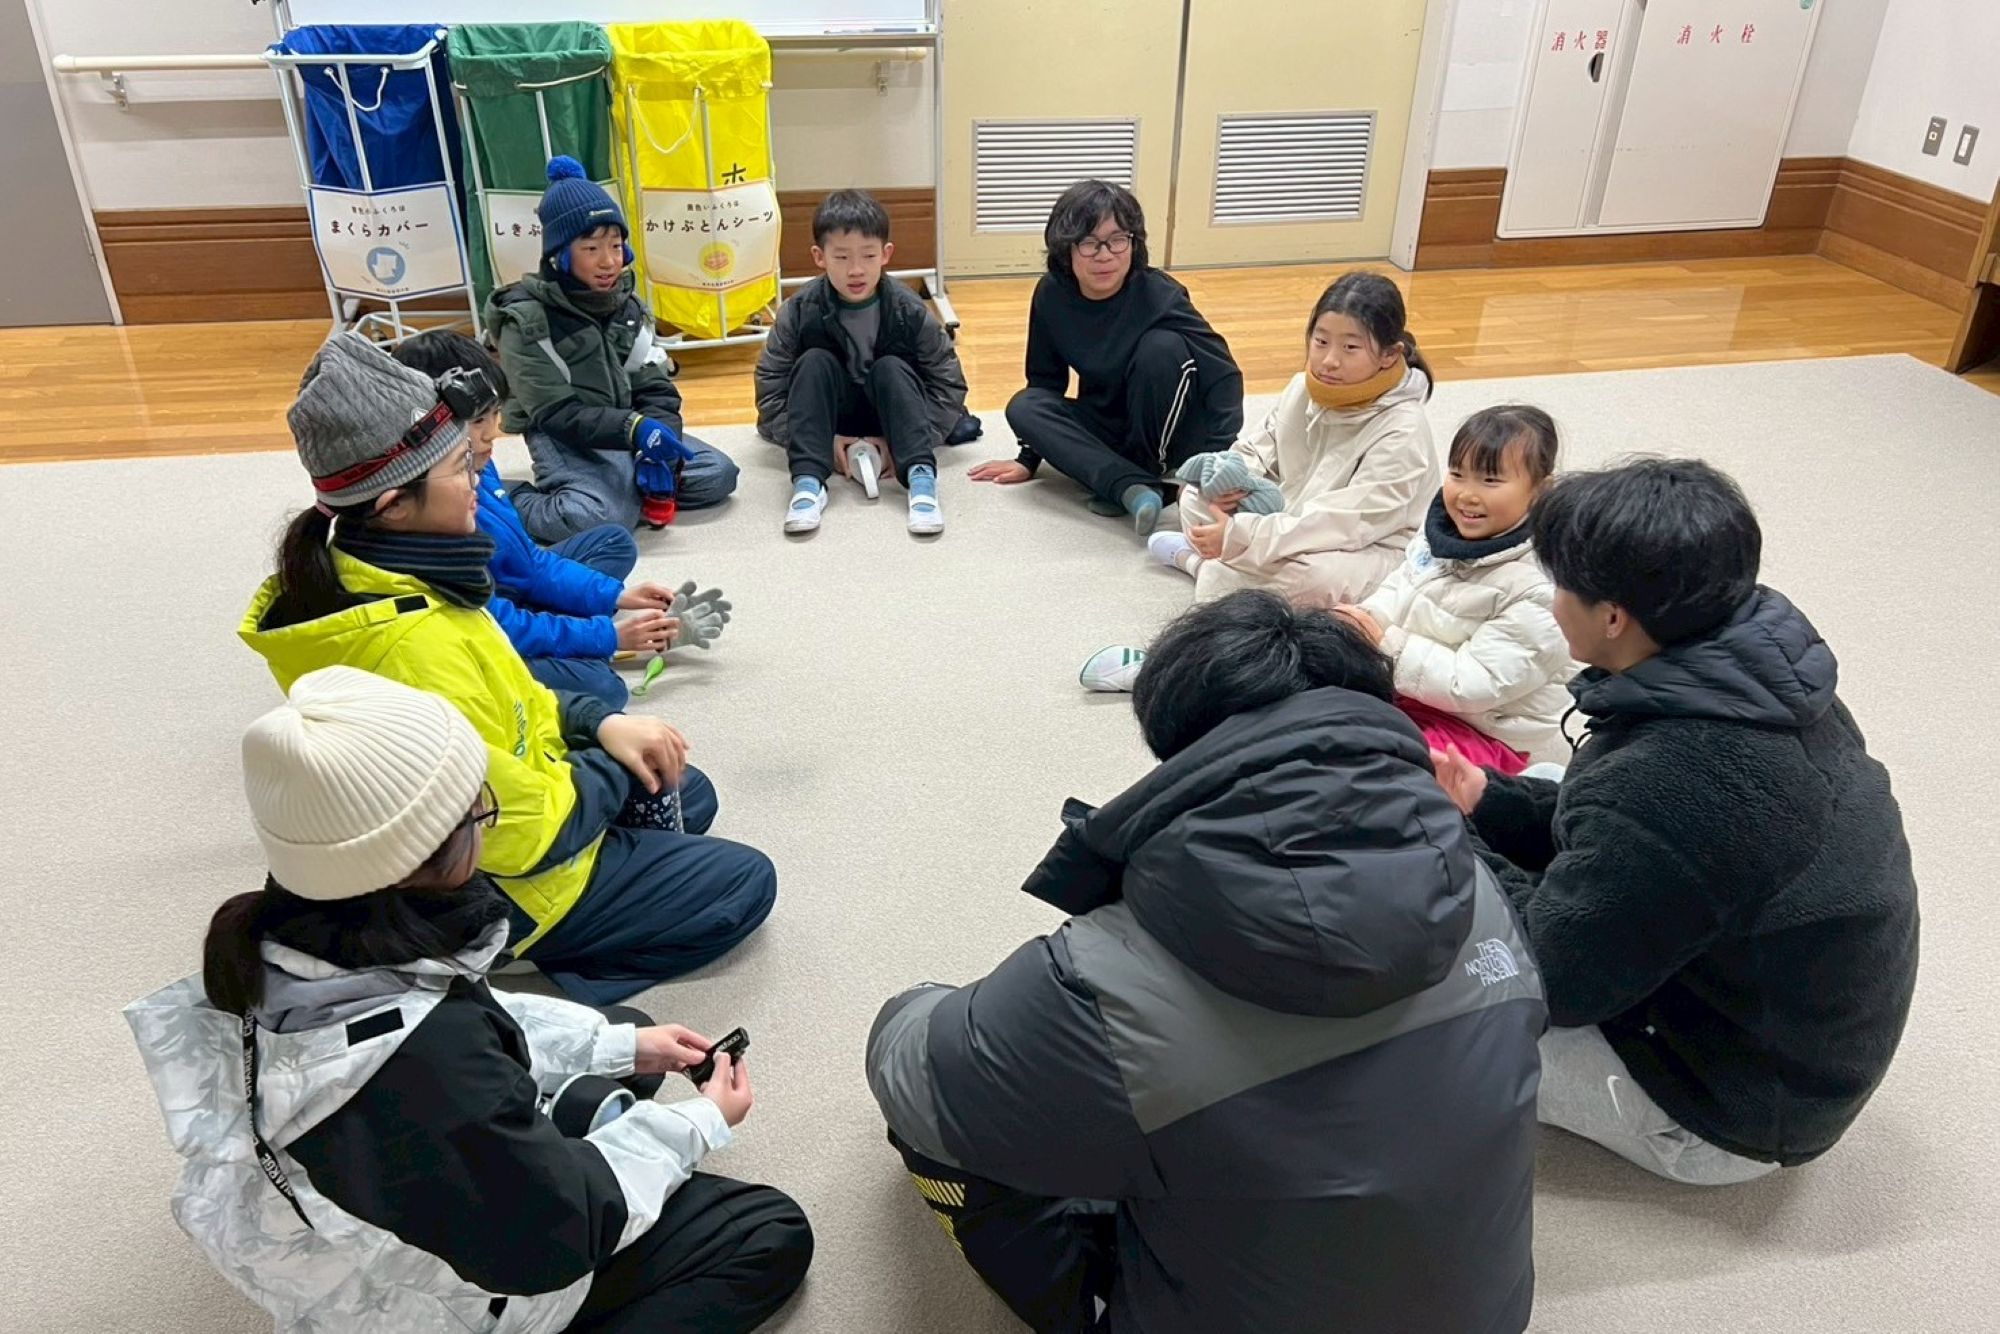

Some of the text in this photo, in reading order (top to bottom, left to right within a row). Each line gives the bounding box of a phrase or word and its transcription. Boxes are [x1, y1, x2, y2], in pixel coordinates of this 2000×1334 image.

[1550, 30, 1608, 51] 消火器
[1676, 24, 1755, 44] 消火栓
[331, 219, 429, 238] まくらカバー
[645, 211, 774, 233] かけぶとんシーツ
